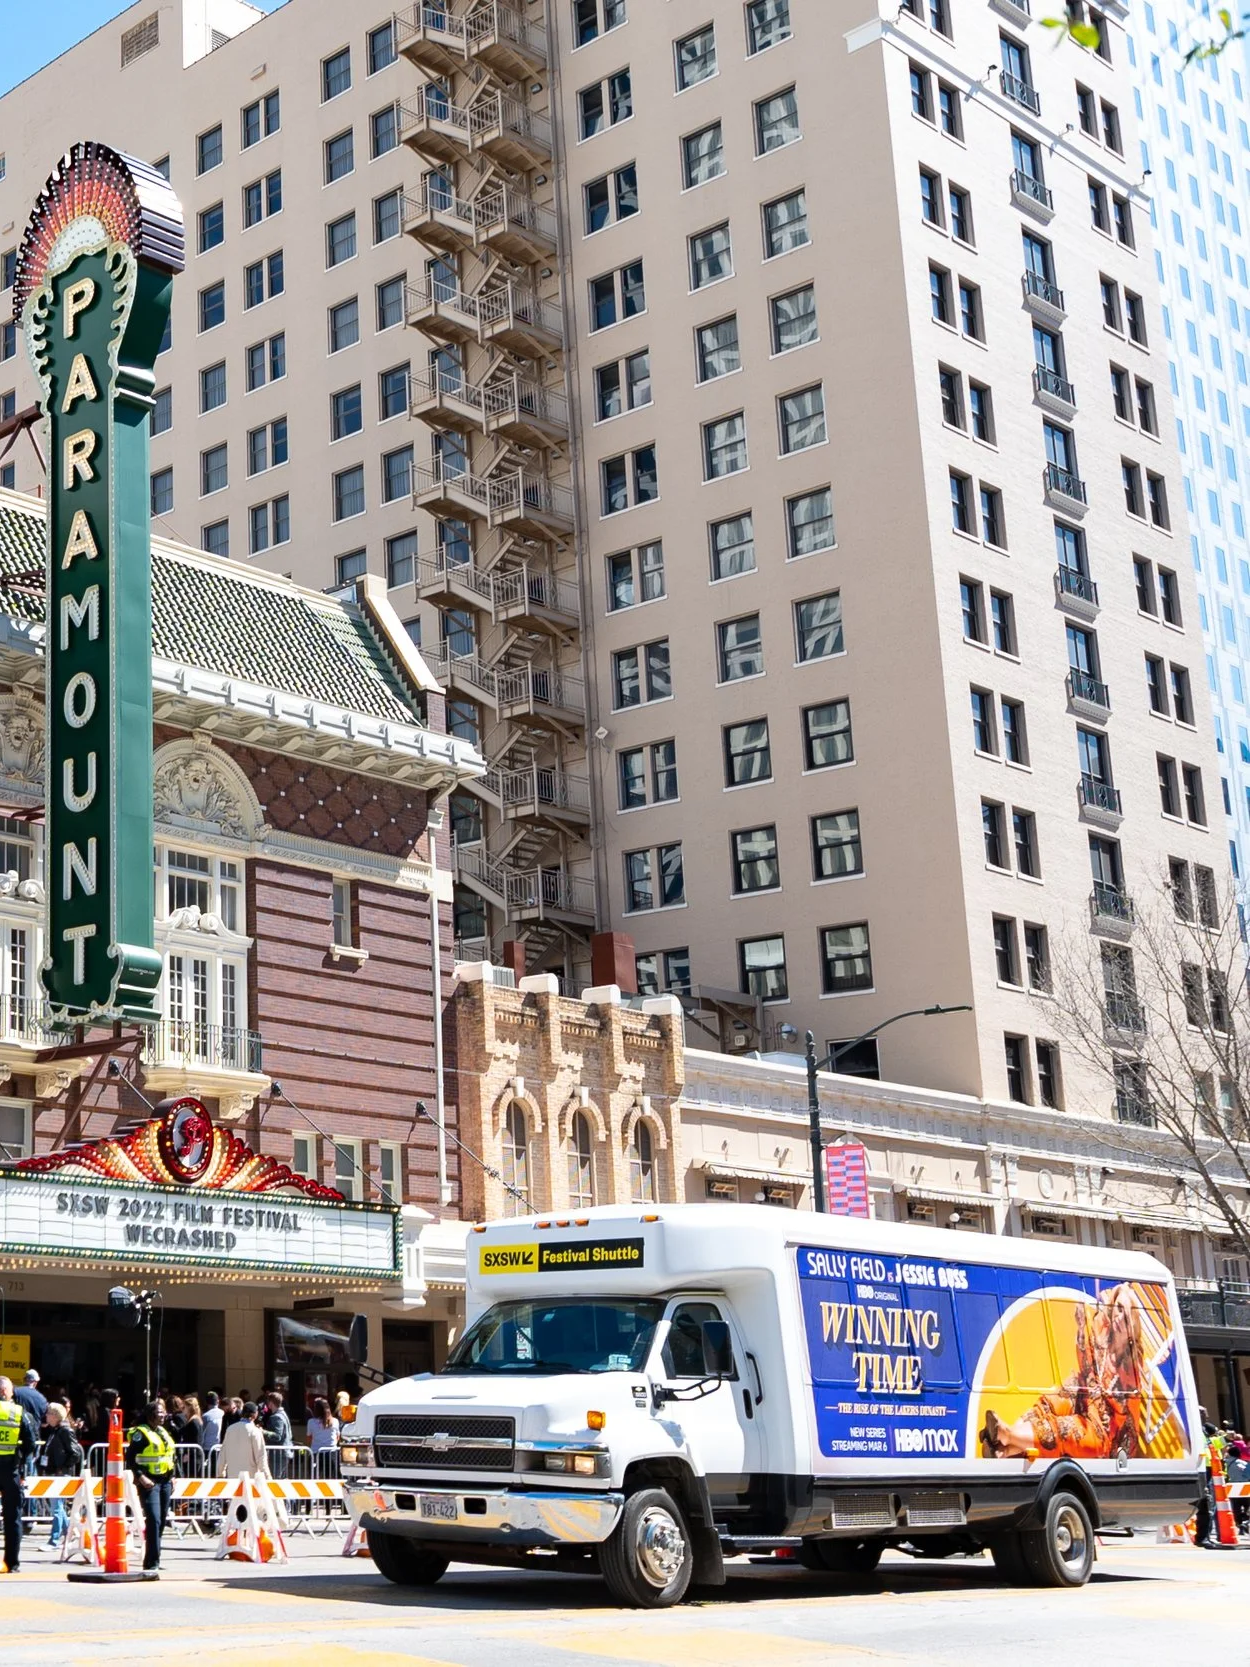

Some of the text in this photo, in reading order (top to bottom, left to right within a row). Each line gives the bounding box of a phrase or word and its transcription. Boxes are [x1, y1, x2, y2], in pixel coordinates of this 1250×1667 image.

[59, 276, 100, 987] PARAMOUNT
[56, 1192, 302, 1232] SXSW 2022 FILM FESTIVAL
[125, 1223, 237, 1250] WECRASHED
[484, 1245, 639, 1267] SXSW Festival Shuttle
[807, 1252, 847, 1278] SALLY
[850, 1257, 886, 1282] FIELD
[895, 1263, 936, 1287] JESSIE
[7, 1280, 25, 1292] 713
[856, 1284, 899, 1302] HBO ORIGINAL
[819, 1301, 940, 1350] WINNING
[4, 1361, 21, 1369] SXSW
[852, 1352, 923, 1395] TIME
[838, 1402, 947, 1416] THE RISE OF THE LAKERS DYNASTY
[850, 1427, 886, 1438] NEW SERIES
[832, 1440, 888, 1452] STREAMING MAR 6
